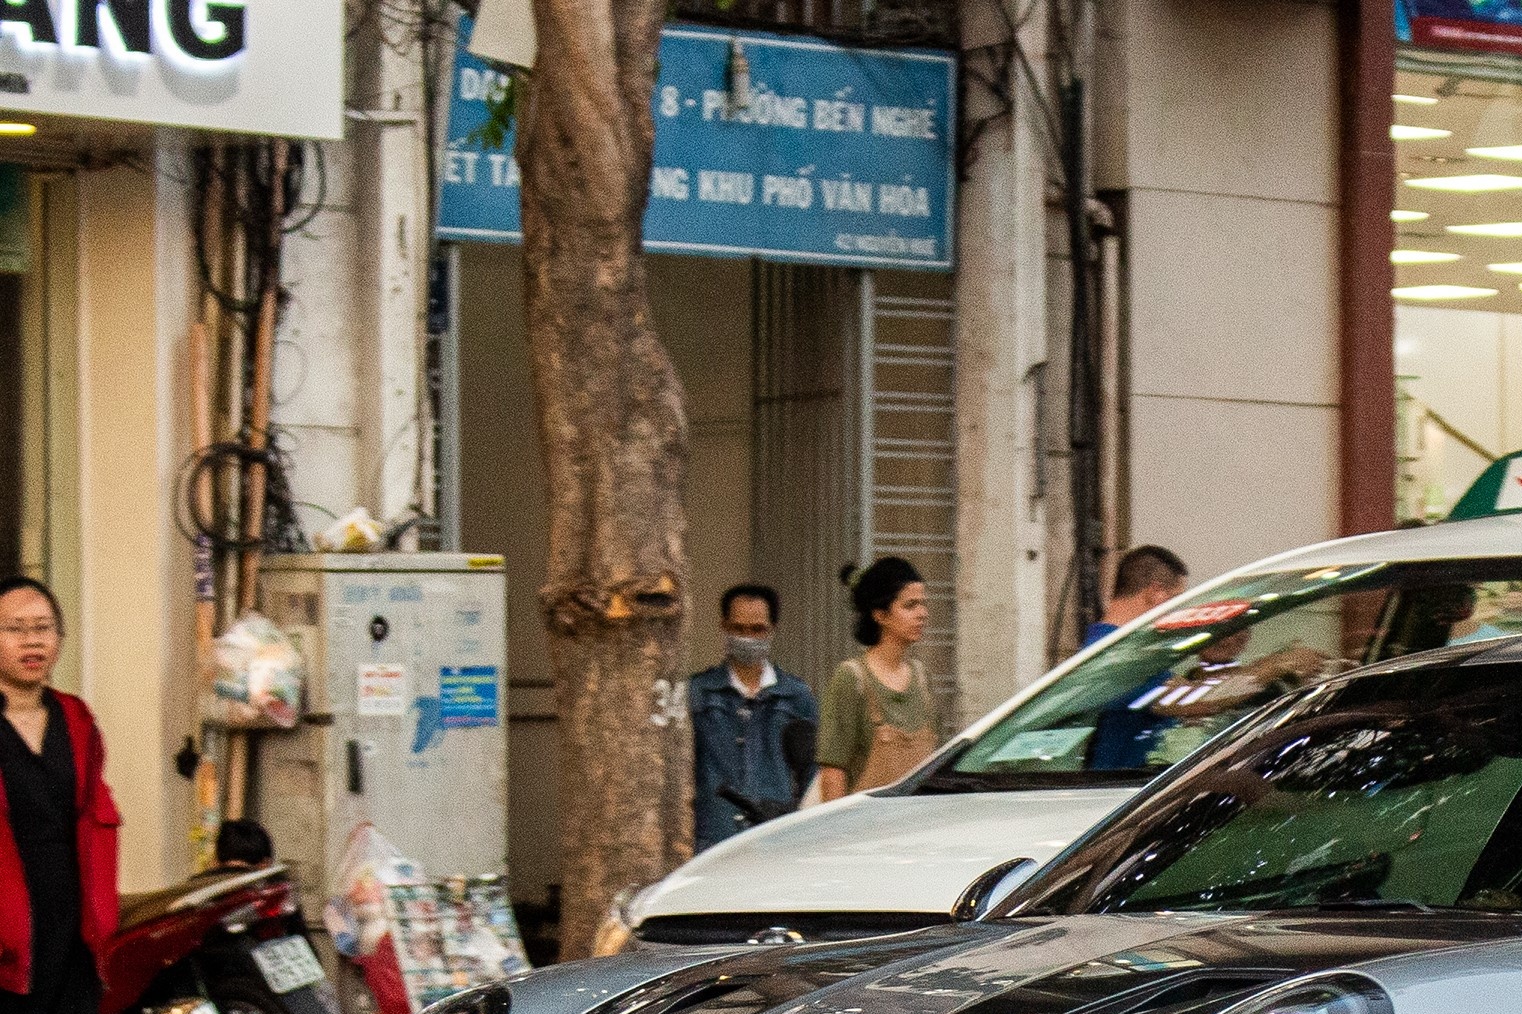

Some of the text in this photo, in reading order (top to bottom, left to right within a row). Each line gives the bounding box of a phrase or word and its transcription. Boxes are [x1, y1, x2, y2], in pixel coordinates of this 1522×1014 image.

[660, 85, 680, 118] 8
[698, 170, 754, 205] KHU
[762, 164, 814, 209] PHỐ
[820, 173, 873, 212] VĂN
